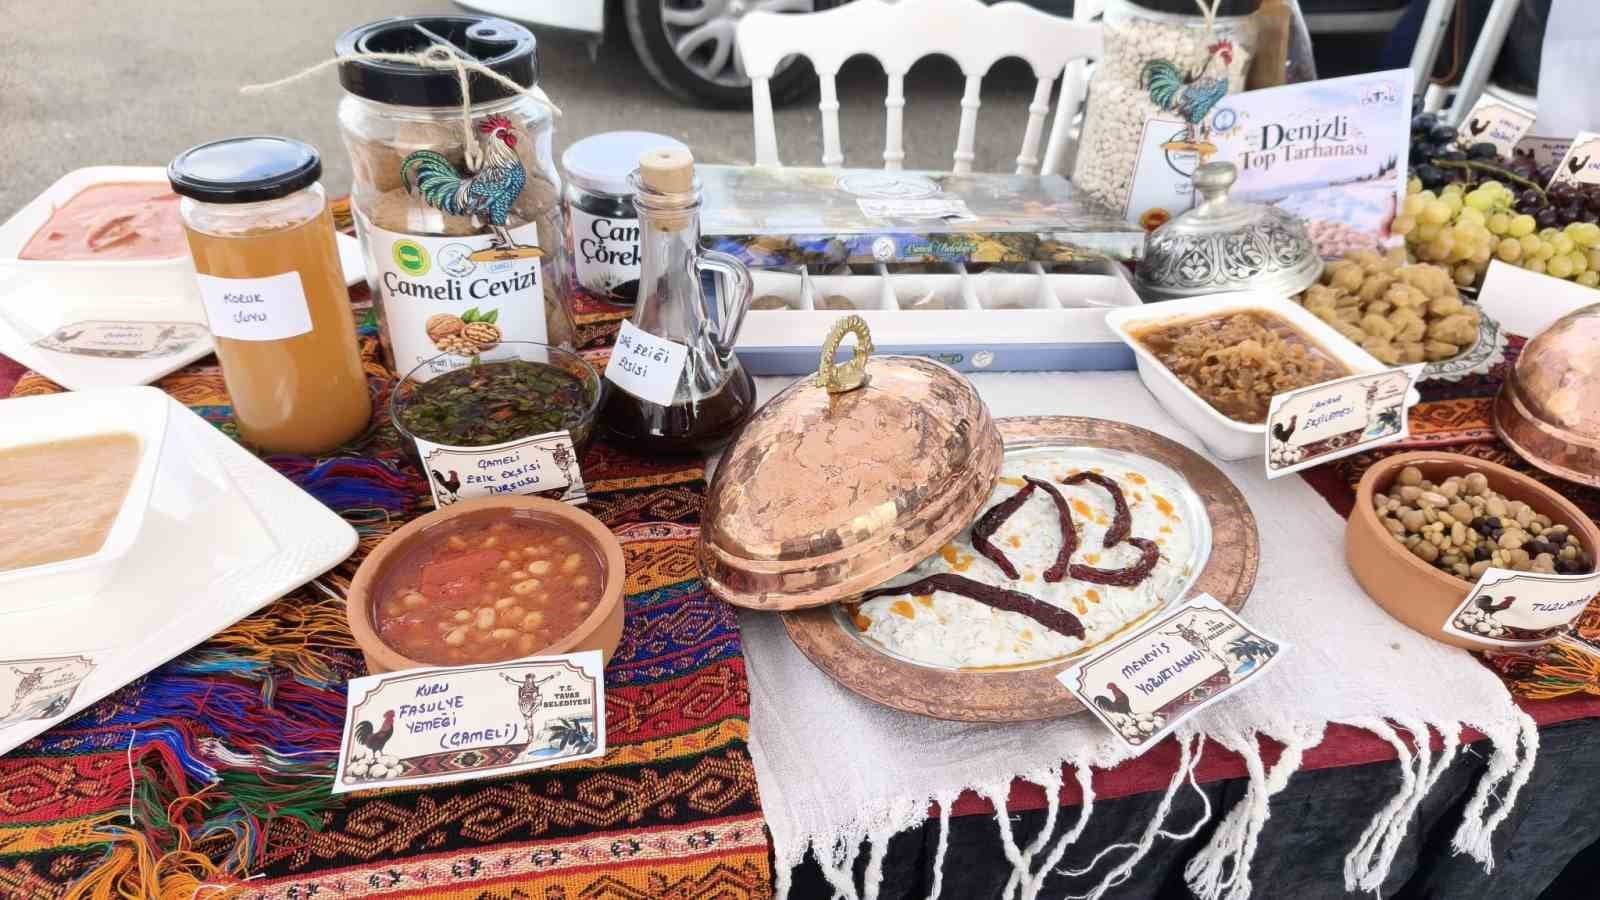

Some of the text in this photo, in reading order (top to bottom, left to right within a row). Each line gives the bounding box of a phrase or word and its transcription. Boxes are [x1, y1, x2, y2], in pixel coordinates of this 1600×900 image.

[1261, 115, 1348, 150] Denizli
[1238, 142, 1369, 171] Top Tarhanası
[383, 265, 537, 301] Çameli Cevizi
[415, 682, 449, 698] KURU
[554, 692, 580, 700] TAVAS
[399, 696, 464, 719] FASULYE
[406, 711, 457, 735] YEMEĞİ
